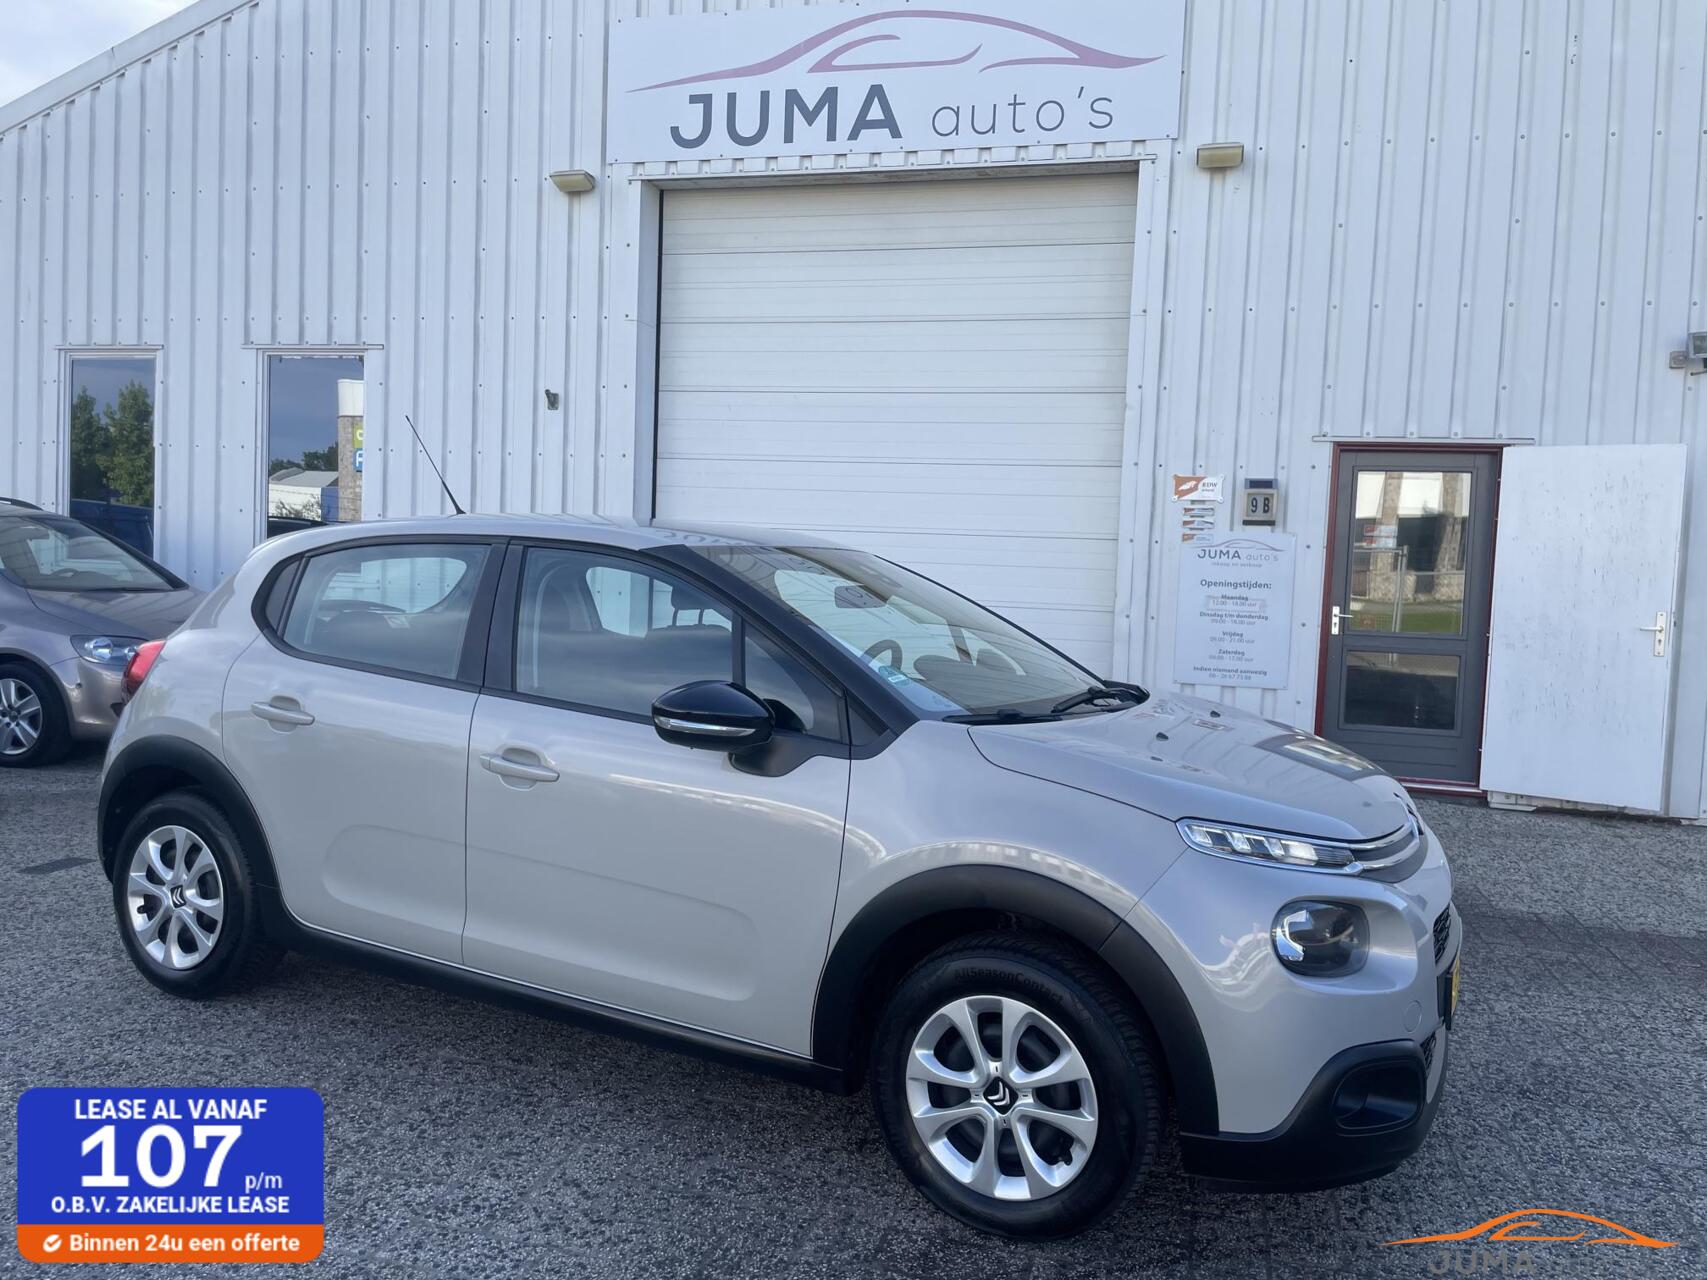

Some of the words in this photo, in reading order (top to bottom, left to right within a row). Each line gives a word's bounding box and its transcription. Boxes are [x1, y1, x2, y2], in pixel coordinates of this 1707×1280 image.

[669, 83, 902, 149] JUMA
[931, 86, 1114, 138] auto's
[1251, 497, 1258, 513] 9
[1263, 497, 1270, 513] B
[1197, 548, 1241, 560] JUMA
[1245, 552, 1279, 562] auto's
[1200, 578, 1272, 590] Openingstijden:
[1221, 594, 1249, 602] Maandag
[1199, 611, 1223, 619] Dinsdag
[1236, 613, 1269, 621] donderdag
[1222, 631, 1244, 639] Vrijdag
[1218, 649, 1245, 657] Zaterdag
[954, 967, 1064, 1004] AllSeasonContact
